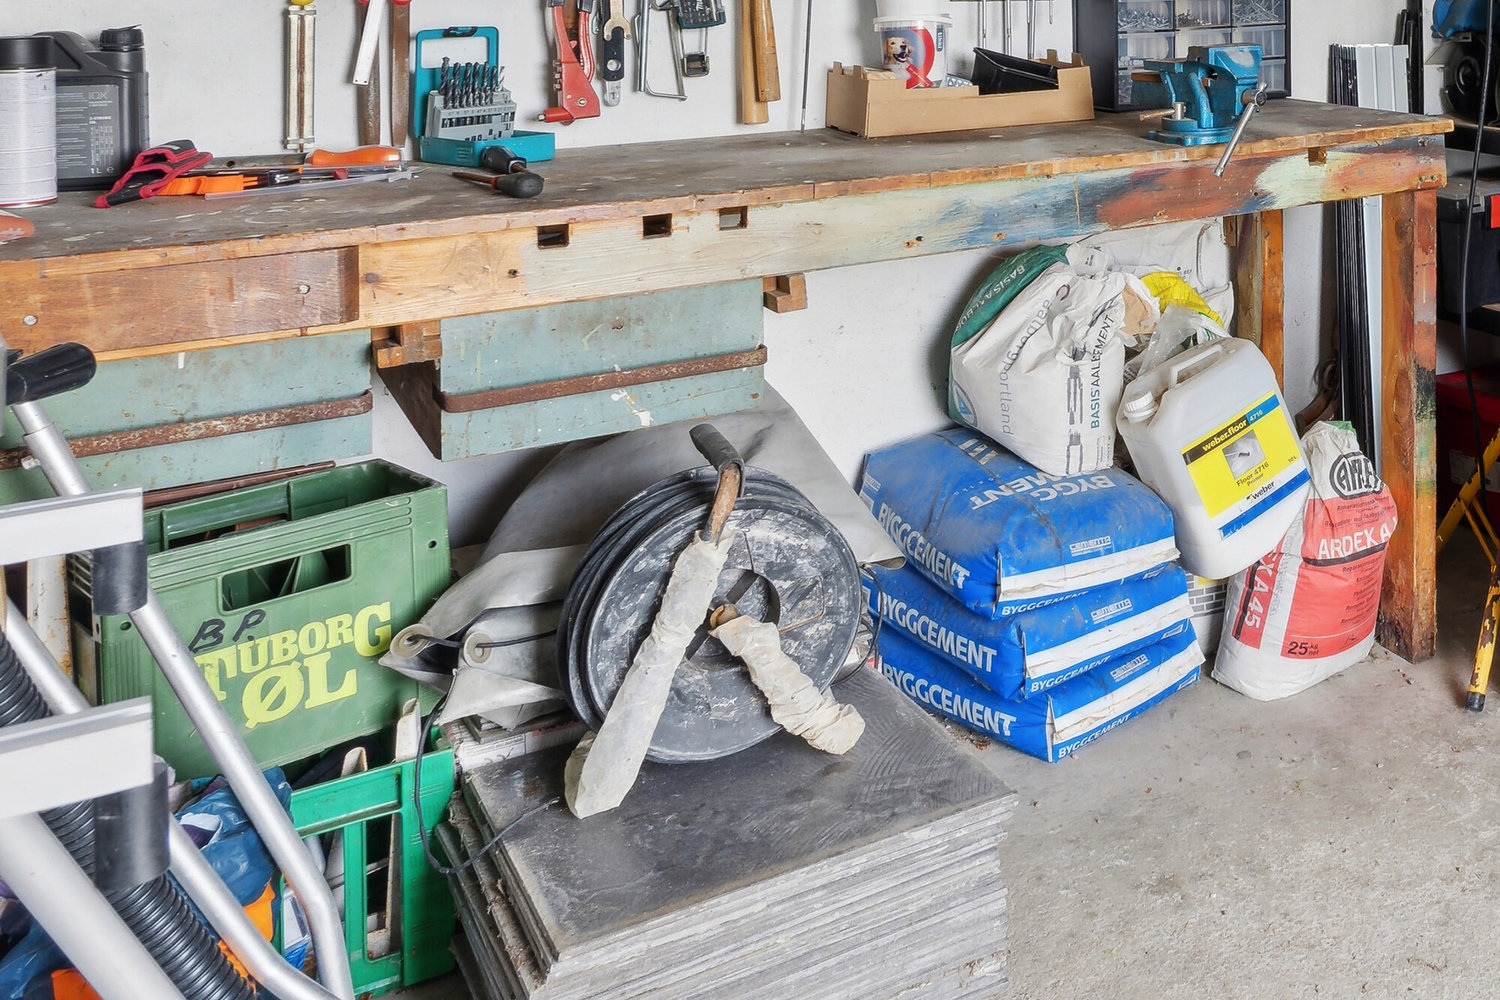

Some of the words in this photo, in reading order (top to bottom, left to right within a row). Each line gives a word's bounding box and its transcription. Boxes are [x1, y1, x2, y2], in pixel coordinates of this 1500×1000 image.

[1090, 389, 1100, 429] BASIS
[1202, 420, 1247, 452] weber.floor
[1249, 410, 1263, 422] 4716
[1030, 474, 1117, 502] BYGG
[1236, 472, 1254, 487] Floor
[1254, 462, 1269, 475] 4716
[1252, 481, 1275, 500] weber
[878, 503, 971, 590] BYGGCEMENT
[877, 592, 997, 673] BYGGCEMENT
[1245, 596, 1264, 629] 45
[194, 601, 392, 701] TUBORG
[1288, 641, 1308, 656] 25
[242, 652, 358, 729] ØL
[1031, 655, 1111, 692] BYGGCEMENT
[883, 662, 1017, 737] BYGGCEMENT
[1058, 713, 1131, 758] BYGGCEMENT
